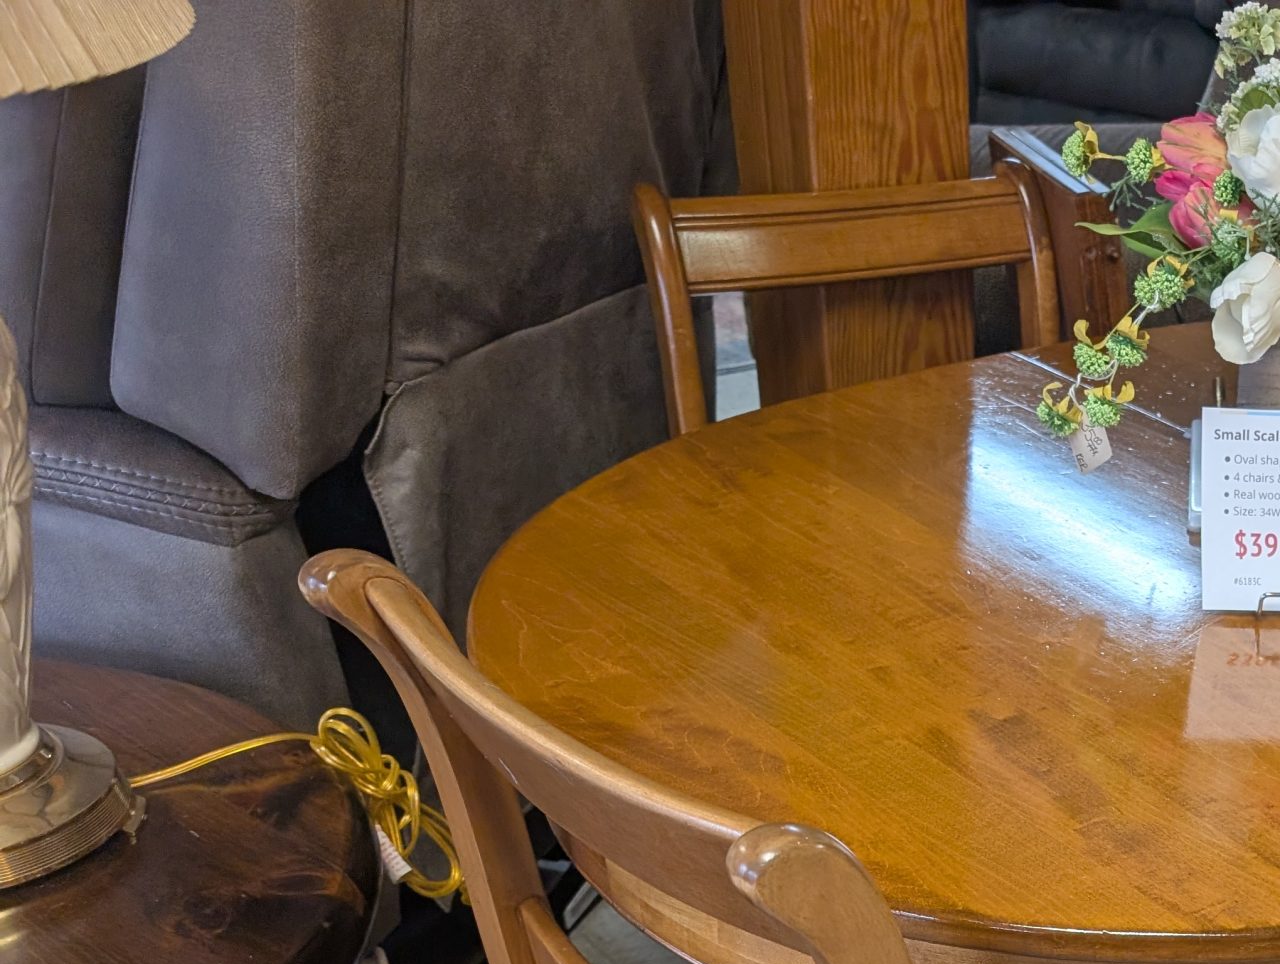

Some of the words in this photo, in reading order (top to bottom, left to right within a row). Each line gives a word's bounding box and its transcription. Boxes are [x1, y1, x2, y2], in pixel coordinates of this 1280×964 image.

[1213, 428, 1250, 442] Small
[1234, 454, 1258, 465] Oval
[1233, 472, 1240, 482] 4
[1243, 472, 1274, 484] chairs
[1234, 489, 1256, 500] Real
[1233, 506, 1257, 517] Size:
